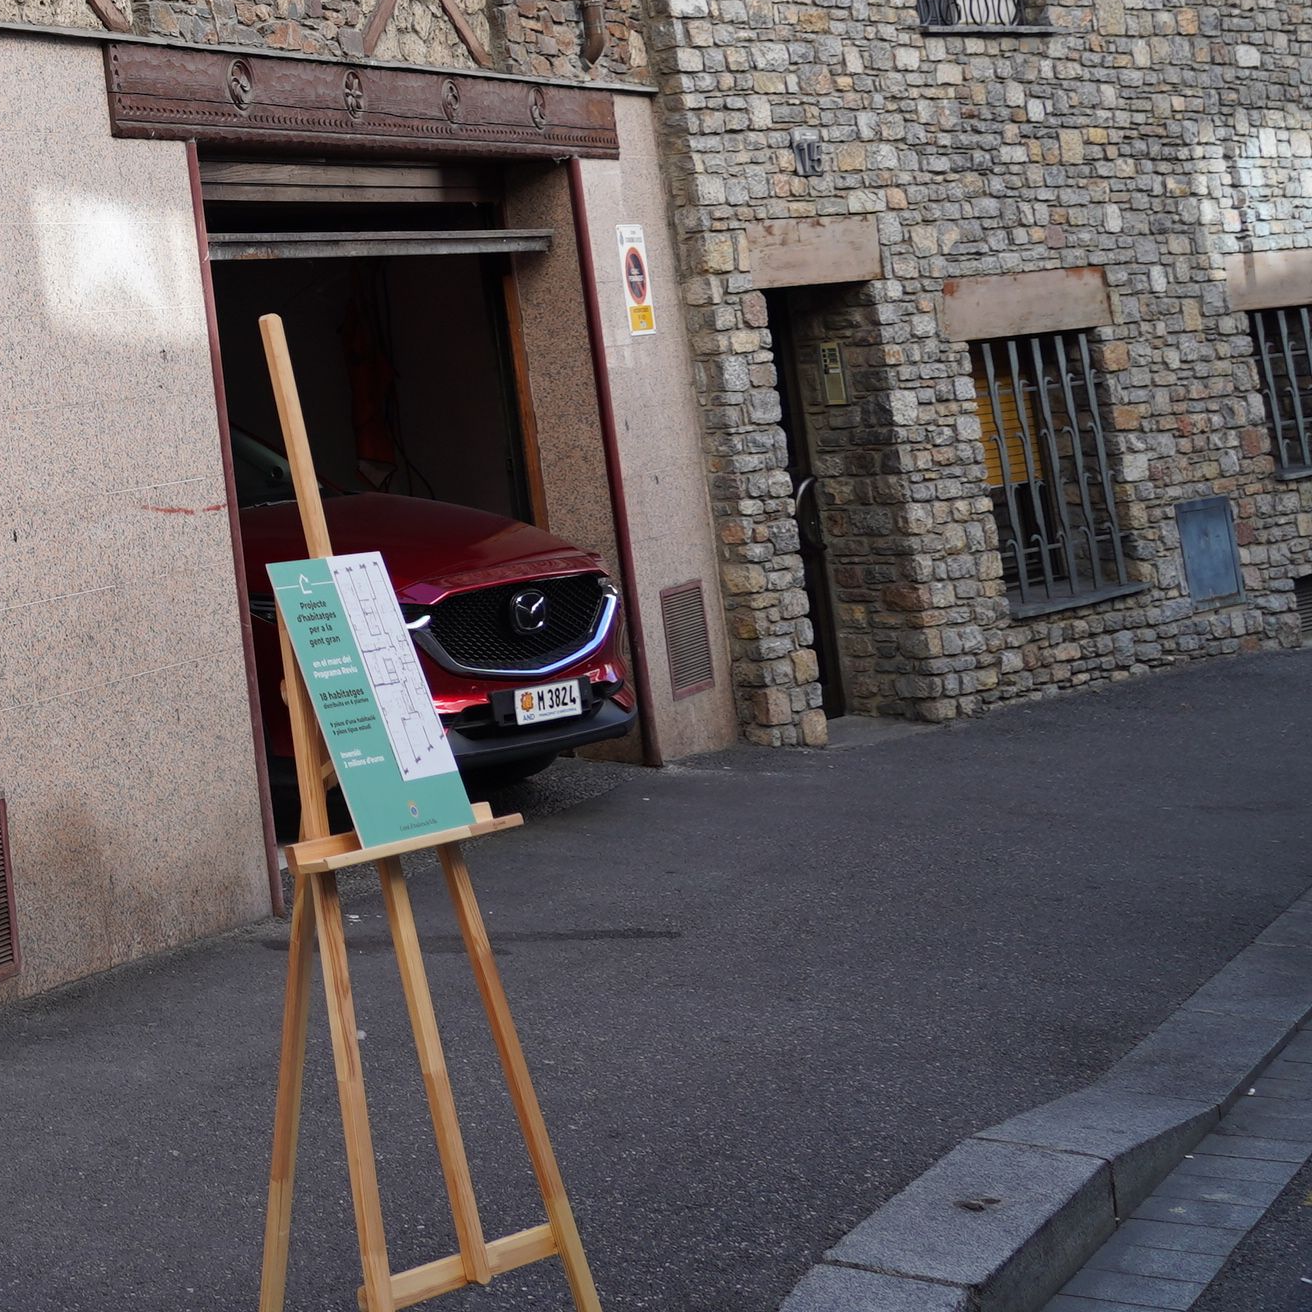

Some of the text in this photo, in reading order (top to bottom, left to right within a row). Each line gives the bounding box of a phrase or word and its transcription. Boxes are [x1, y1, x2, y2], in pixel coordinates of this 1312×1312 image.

[796, 141, 823, 174] 15
[299, 600, 327, 610] Projecte
[297, 611, 337, 623] d'habitatges
[309, 626, 320, 635] per
[325, 623, 333, 631] la
[309, 635, 341, 648] gent gran
[312, 655, 352, 668] en el marc del
[313, 669, 342, 679] Programa
[319, 688, 365, 701] 18 habitatges
[537, 685, 576, 711] M 3824
[522, 713, 536, 721] AND
